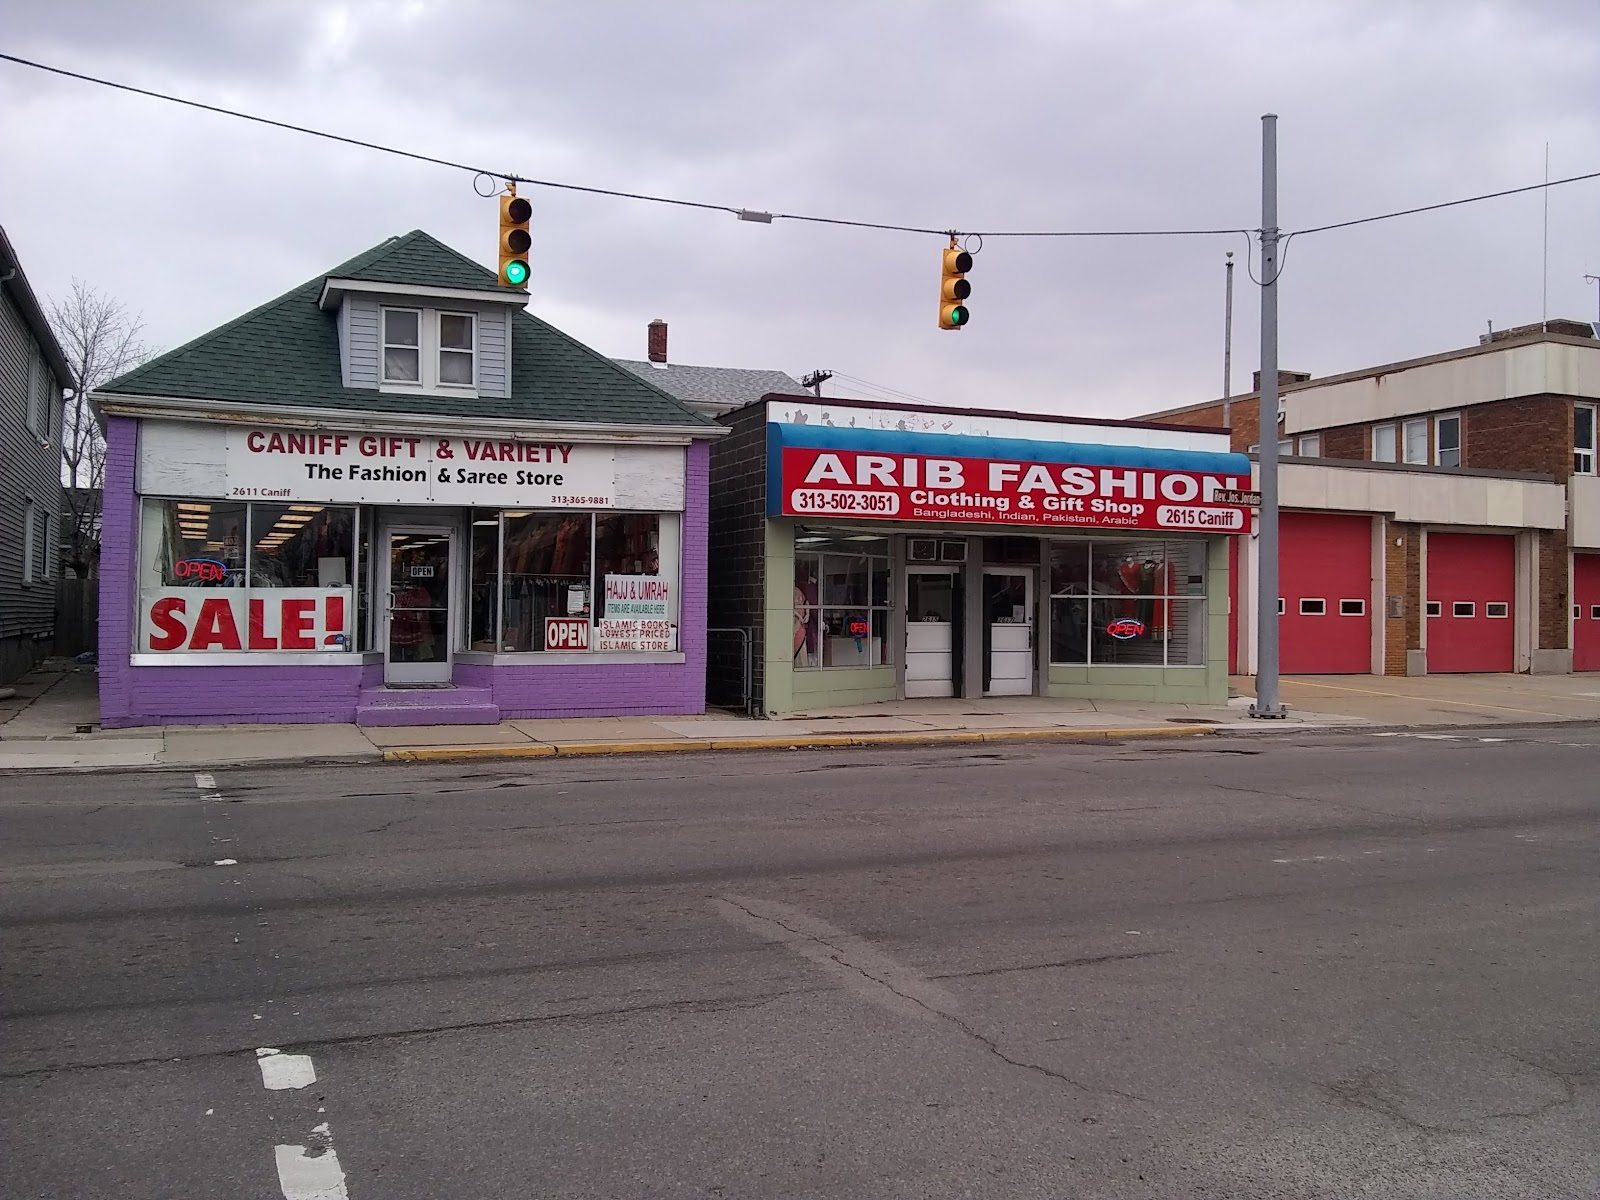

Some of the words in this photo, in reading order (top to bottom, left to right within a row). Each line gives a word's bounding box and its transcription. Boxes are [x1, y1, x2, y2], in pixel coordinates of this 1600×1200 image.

[247, 431, 349, 456] CANIFF
[358, 436, 420, 458] GIFT
[436, 439, 454, 459] &
[463, 440, 574, 464] VARIETY
[305, 463, 342, 480] The
[349, 464, 427, 482] Fashion
[437, 467, 451, 484] &
[456, 468, 508, 485] Saree
[516, 470, 564, 486] Store
[803, 453, 965, 489] ARIB
[988, 462, 1237, 503] FASHION
[232, 487, 257, 496] 2611
[261, 488, 291, 497] Caniff
[551, 495, 609, 505] 313-365-9881
[799, 492, 893, 511] 313-502-3051
[910, 490, 1010, 511] Clothing
[1018, 495, 1035, 510] &
[1043, 496, 1084, 512] Gift
[1091, 499, 1144, 517] Shop
[913, 508, 994, 520] Bangladeshi,
[999, 512, 1039, 521] Indian,
[1043, 514, 1099, 524] Pakistani,
[1101, 516, 1138, 525] Arabic
[1166, 509, 1195, 524] 2615
[1198, 510, 1234, 526] Caniff
[174, 560, 225, 581] OPEN
[412, 567, 432, 576] OPEN
[606, 581, 628, 600] HAJJ
[630, 581, 636, 600] &
[638, 581, 668, 601] UMRAH
[607, 603, 620, 614] ITEMS
[621, 603, 630, 614] ARE
[630, 604, 653, 614] AVAILABLE
[653, 604, 665, 615] HERE
[149, 596, 344, 651] SALE!
[600, 621, 638, 630] ISLAMIC
[641, 621, 669, 630] BOOKS
[851, 622, 869, 633] OPEN
[1106, 623, 1145, 635] OPEN
[547, 622, 588, 647] OPEN
[600, 630, 637, 638] LOWEST
[640, 630, 671, 639] PRICED
[600, 641, 637, 650] ISLAMIC
[640, 641, 668, 650] STORE
